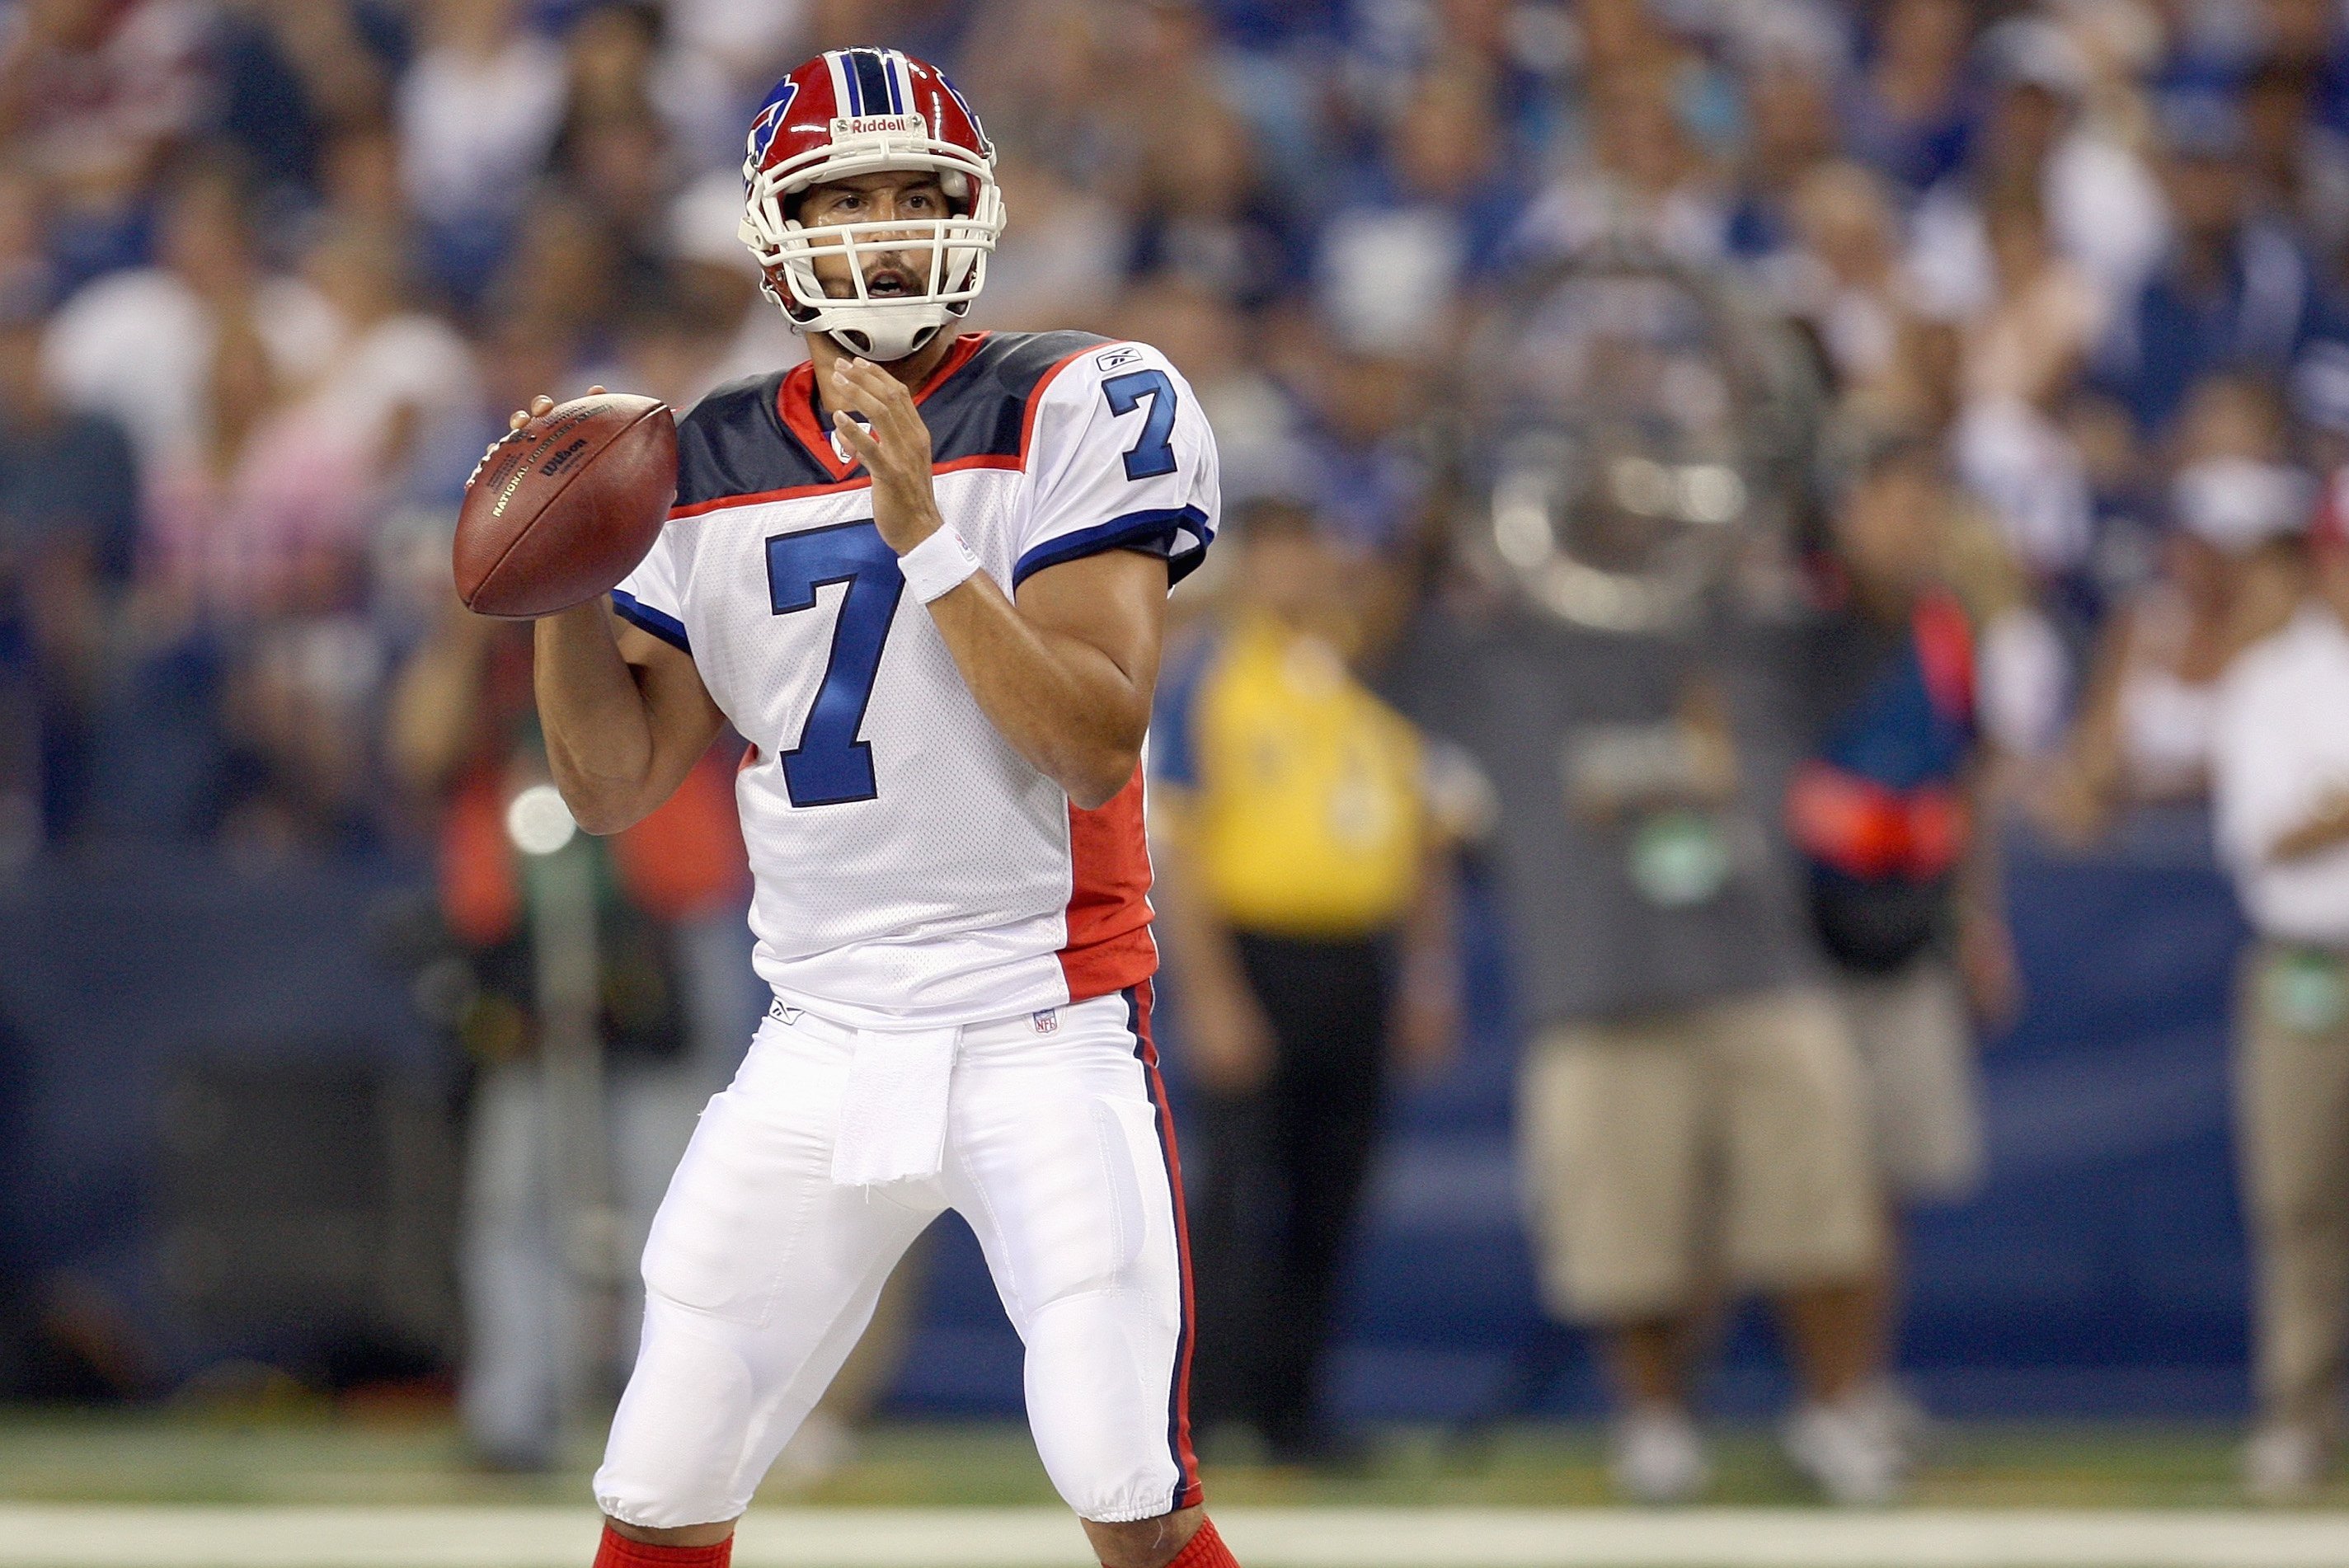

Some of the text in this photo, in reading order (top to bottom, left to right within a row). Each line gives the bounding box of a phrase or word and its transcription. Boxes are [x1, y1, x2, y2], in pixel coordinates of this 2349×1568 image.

[853, 118, 906, 134] Riddell
[1102, 369, 1177, 481] 7
[540, 439, 588, 476] Wilson
[492, 466, 529, 517] NATIONAL
[765, 518, 904, 808] 7
[1036, 1017, 1056, 1030] NFL
